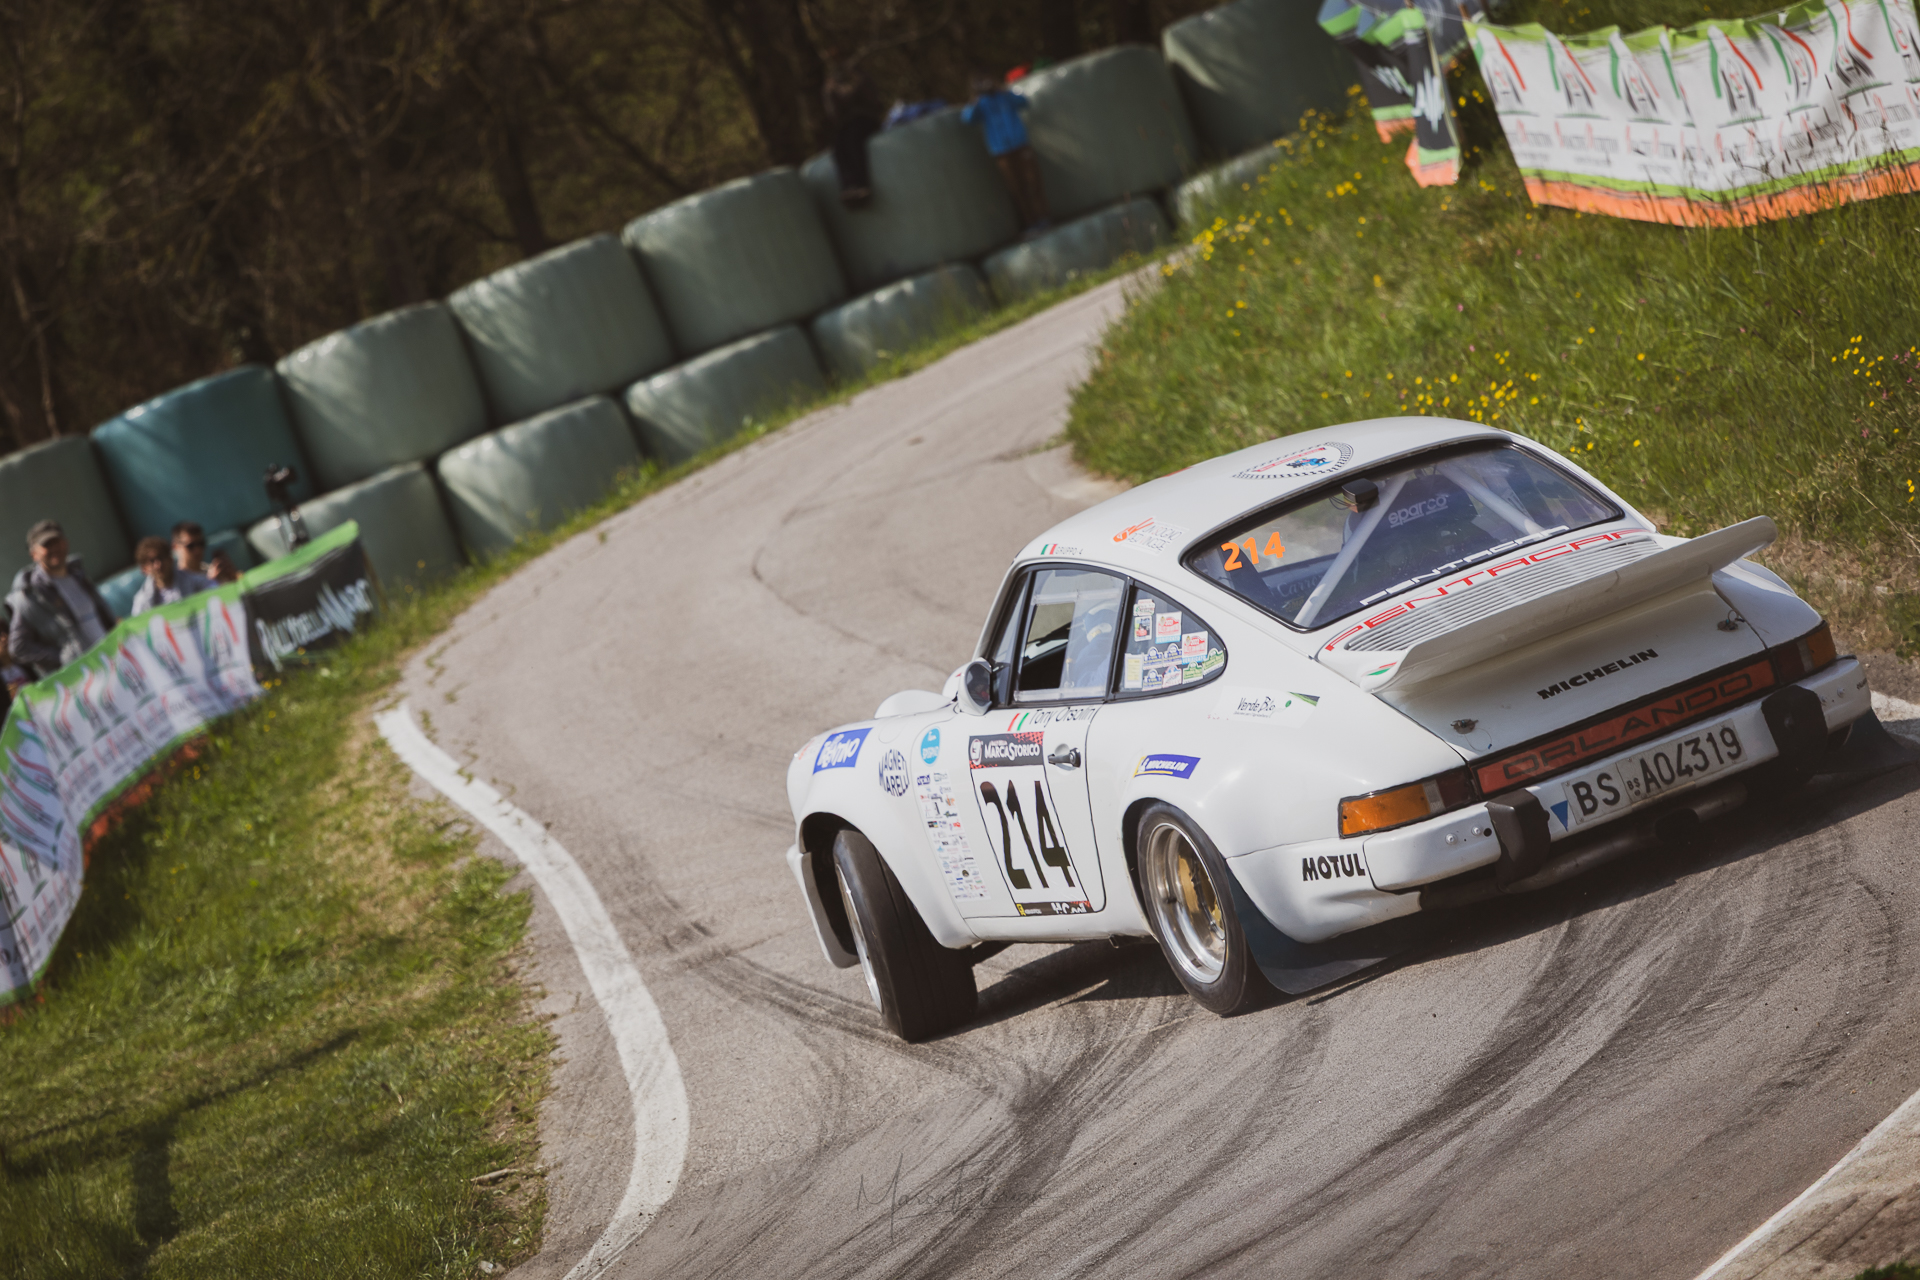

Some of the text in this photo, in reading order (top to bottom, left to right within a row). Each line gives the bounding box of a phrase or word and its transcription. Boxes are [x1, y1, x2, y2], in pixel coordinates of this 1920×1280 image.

[1221, 531, 1286, 572] 214
[1360, 526, 1571, 606] PENTACAR
[1324, 527, 1655, 651] PENTACAR
[1536, 648, 1659, 700] MICHELIN
[1028, 709, 1056, 728] Tony
[1503, 673, 1754, 780] ORLANDO
[1146, 758, 1189, 772] MICHELIN
[1572, 773, 1621, 816] BS
[1638, 726, 1744, 804] A04319
[980, 780, 1076, 890] 214
[1302, 853, 1366, 882] MOTUL
